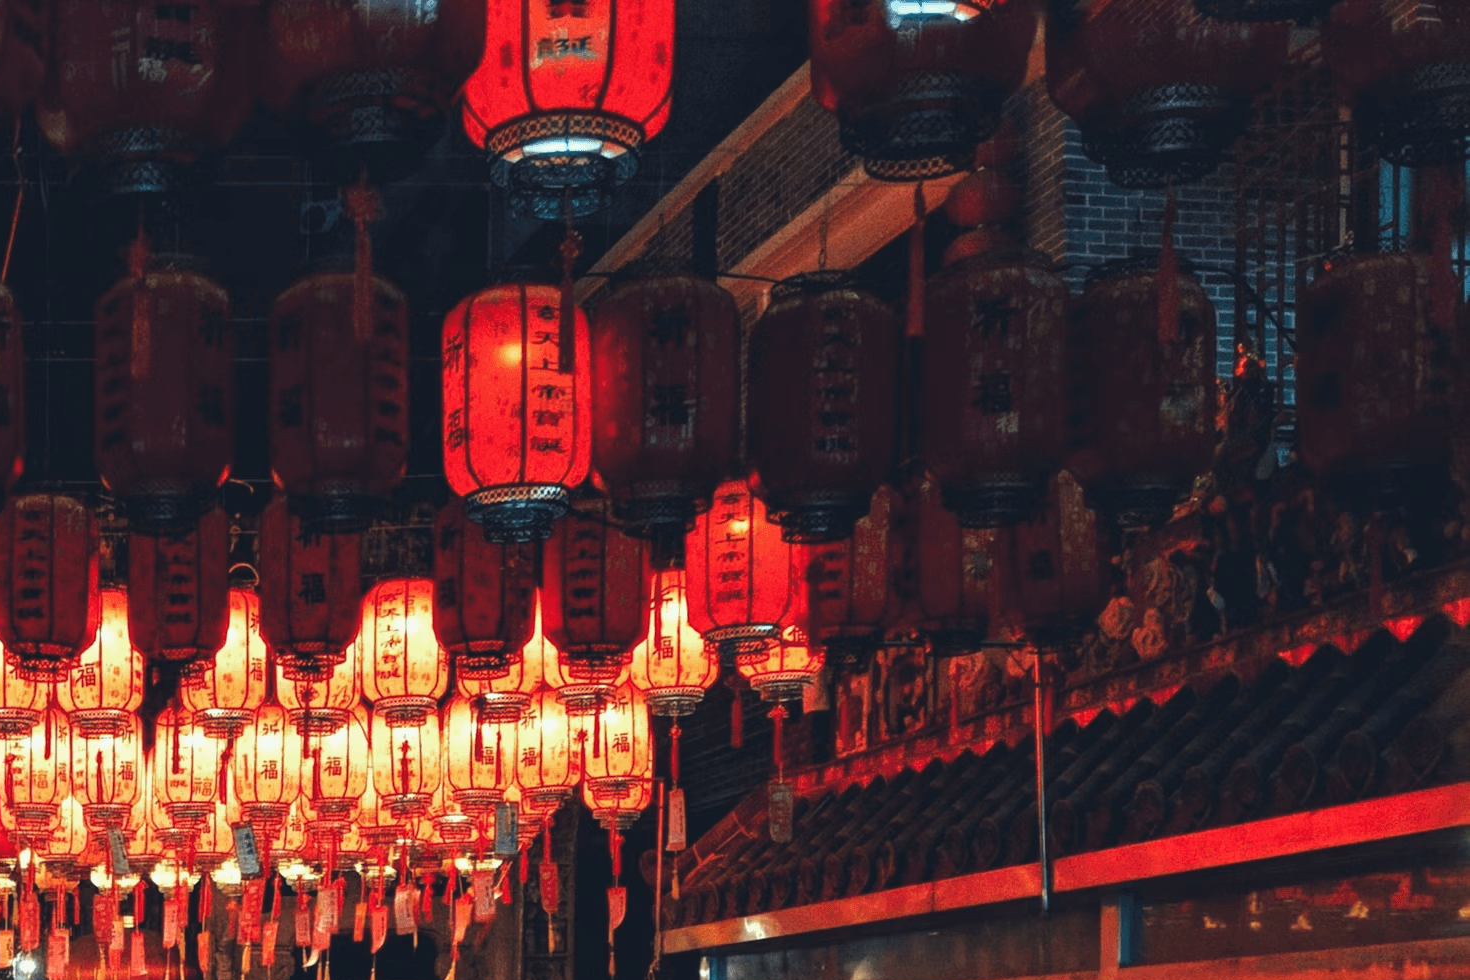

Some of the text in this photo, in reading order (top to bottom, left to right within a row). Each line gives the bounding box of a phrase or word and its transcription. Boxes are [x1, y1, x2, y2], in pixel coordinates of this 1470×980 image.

[76, 662, 96, 688] 福
[261, 722, 279, 781] 祈福
[520, 709, 538, 767] 祈福
[611, 695, 630, 753] 祈福
[324, 756, 343, 777] 福
